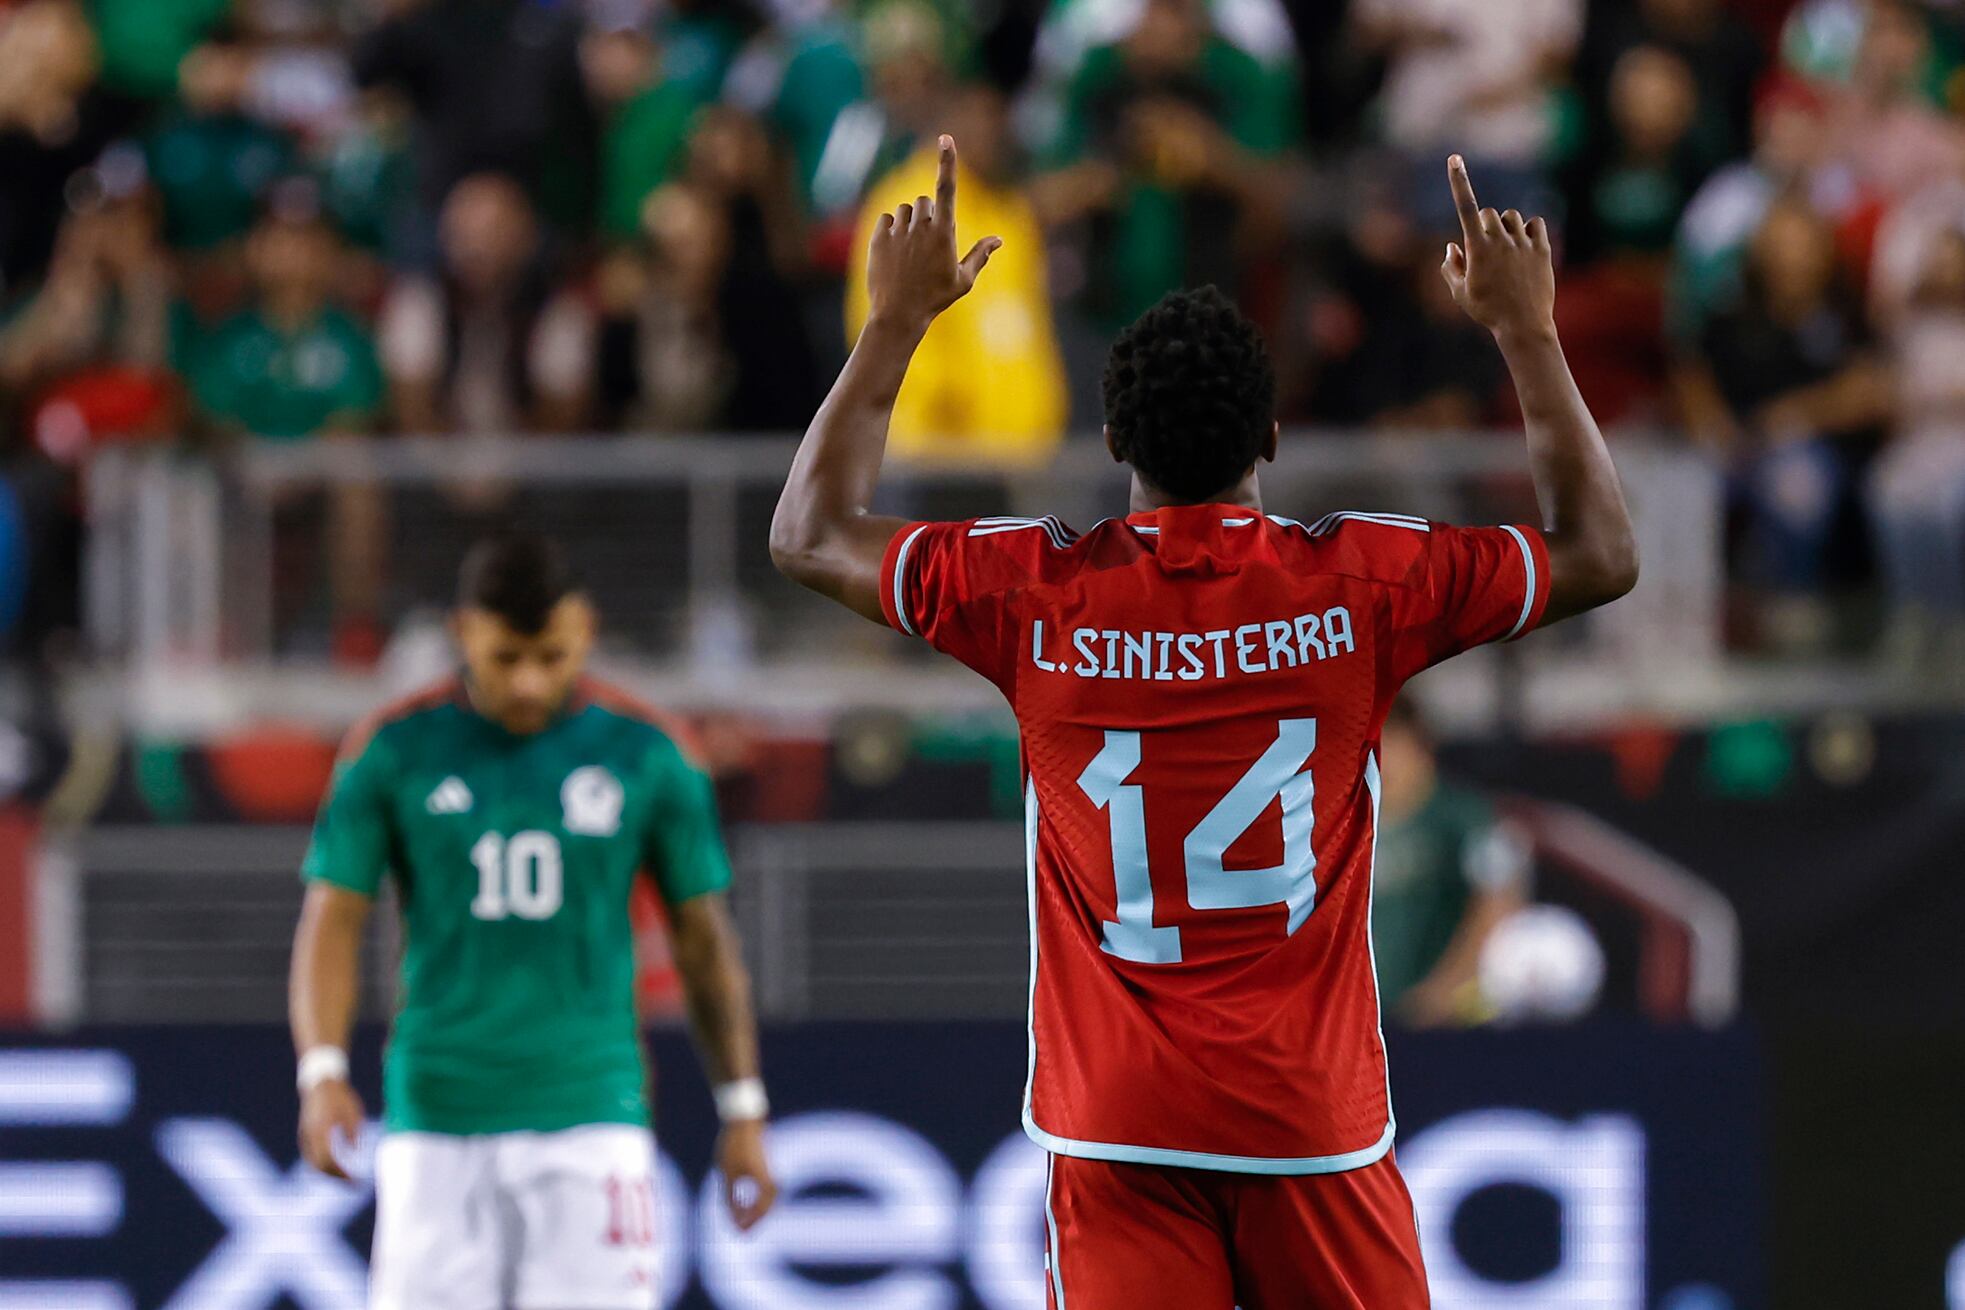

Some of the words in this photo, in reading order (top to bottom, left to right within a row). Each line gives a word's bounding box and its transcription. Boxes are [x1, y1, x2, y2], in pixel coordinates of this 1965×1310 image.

[1032, 605, 1356, 681] L.SINISTERRA
[470, 829, 564, 921] 10
[1076, 717, 1317, 963] 14
